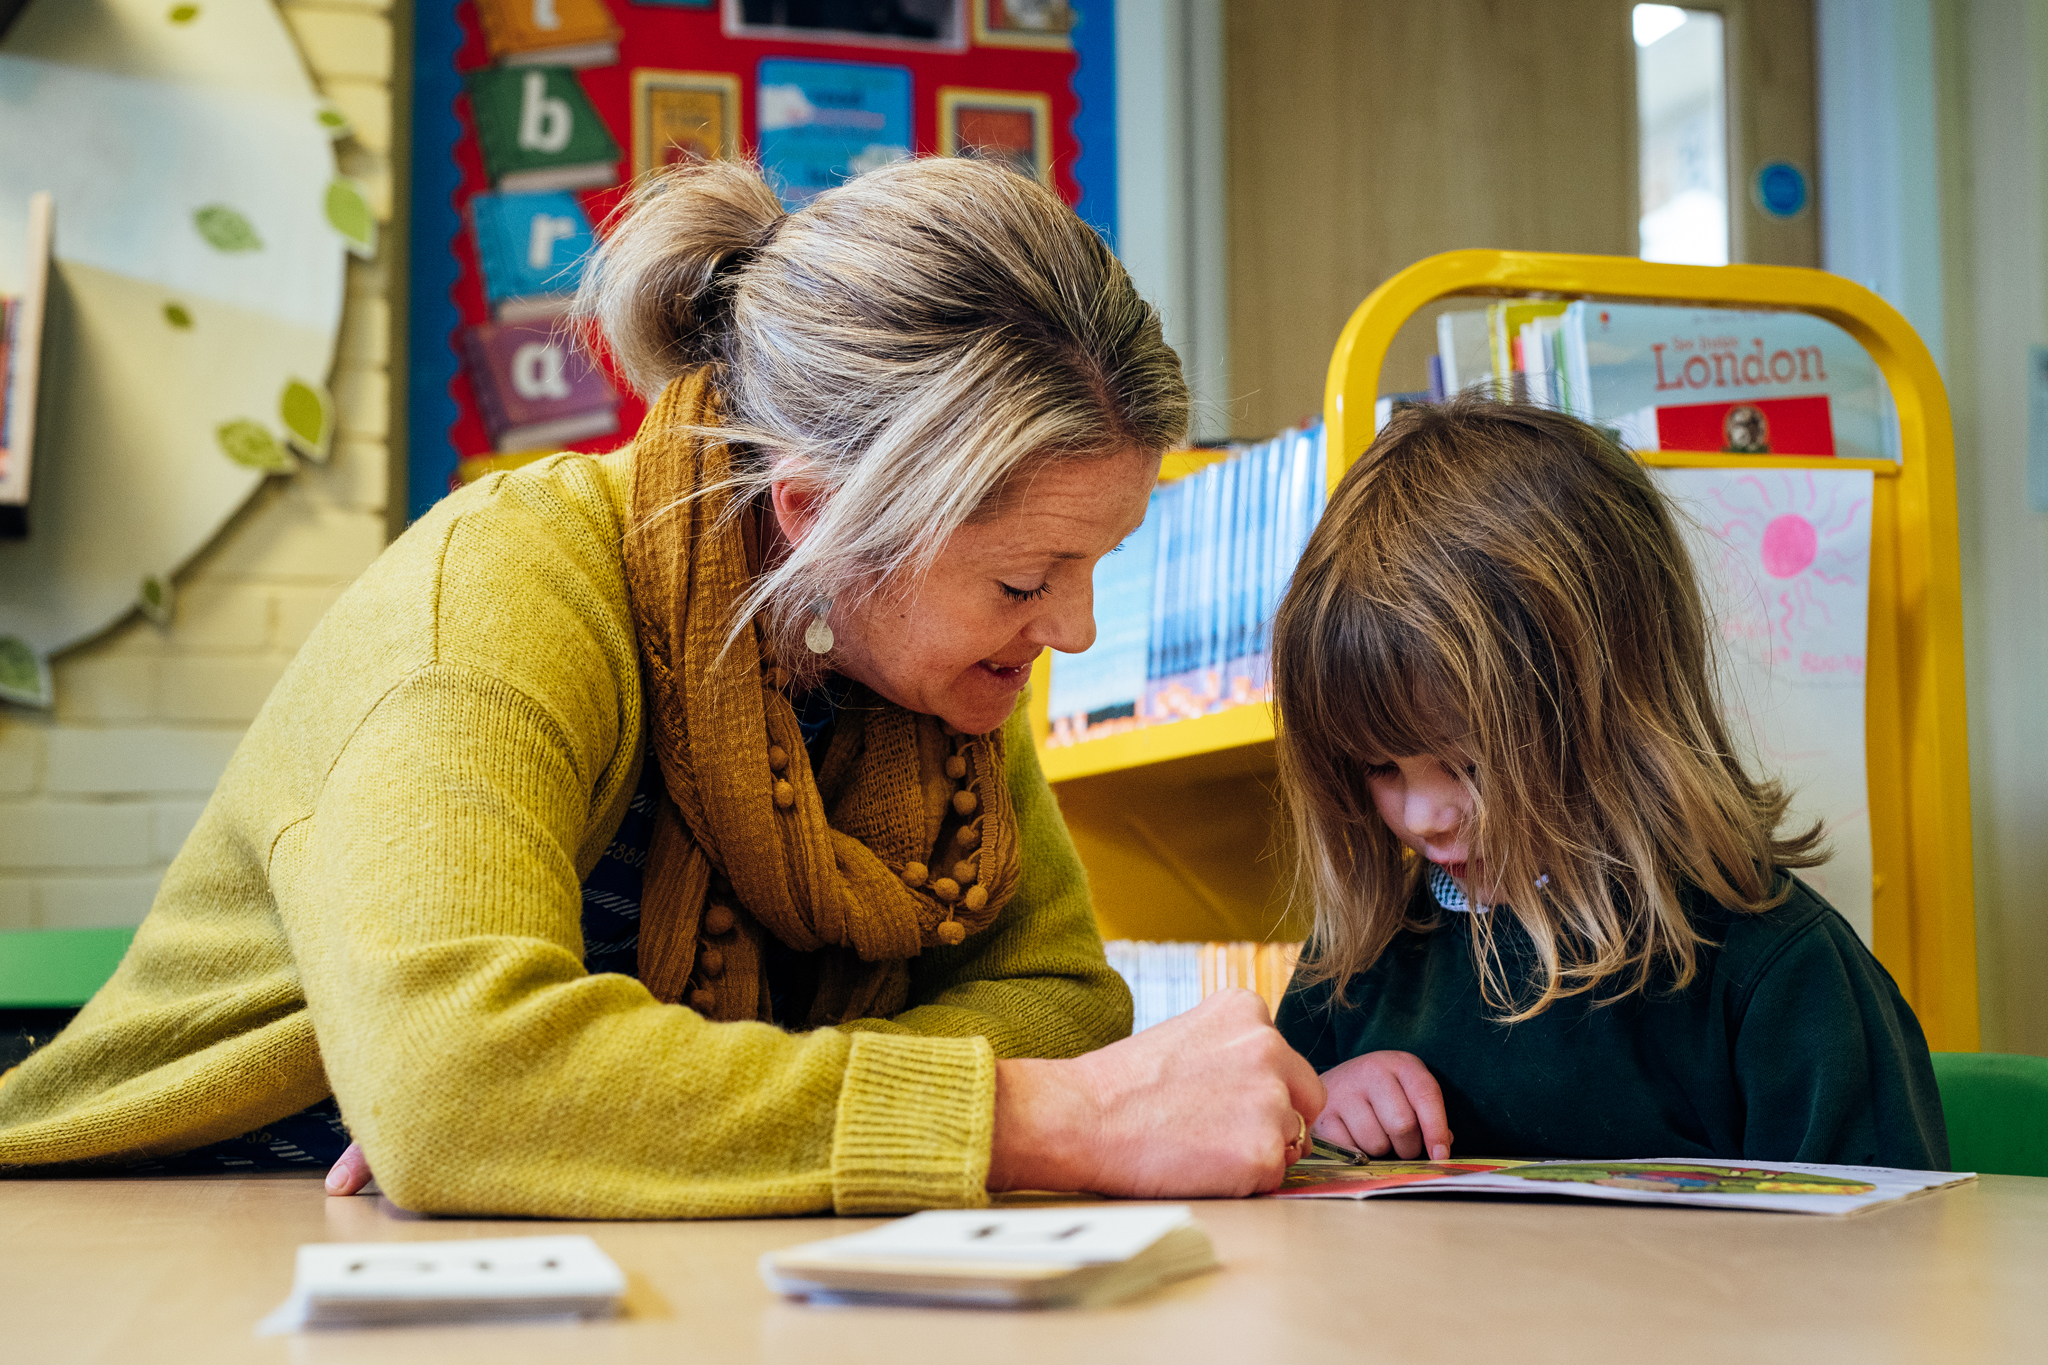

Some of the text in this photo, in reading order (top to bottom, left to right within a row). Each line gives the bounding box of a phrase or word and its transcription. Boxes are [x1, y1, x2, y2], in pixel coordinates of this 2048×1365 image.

[519, 72, 573, 152] b
[529, 214, 575, 268] r
[512, 343, 570, 398] a
[1652, 338, 1828, 391] London
